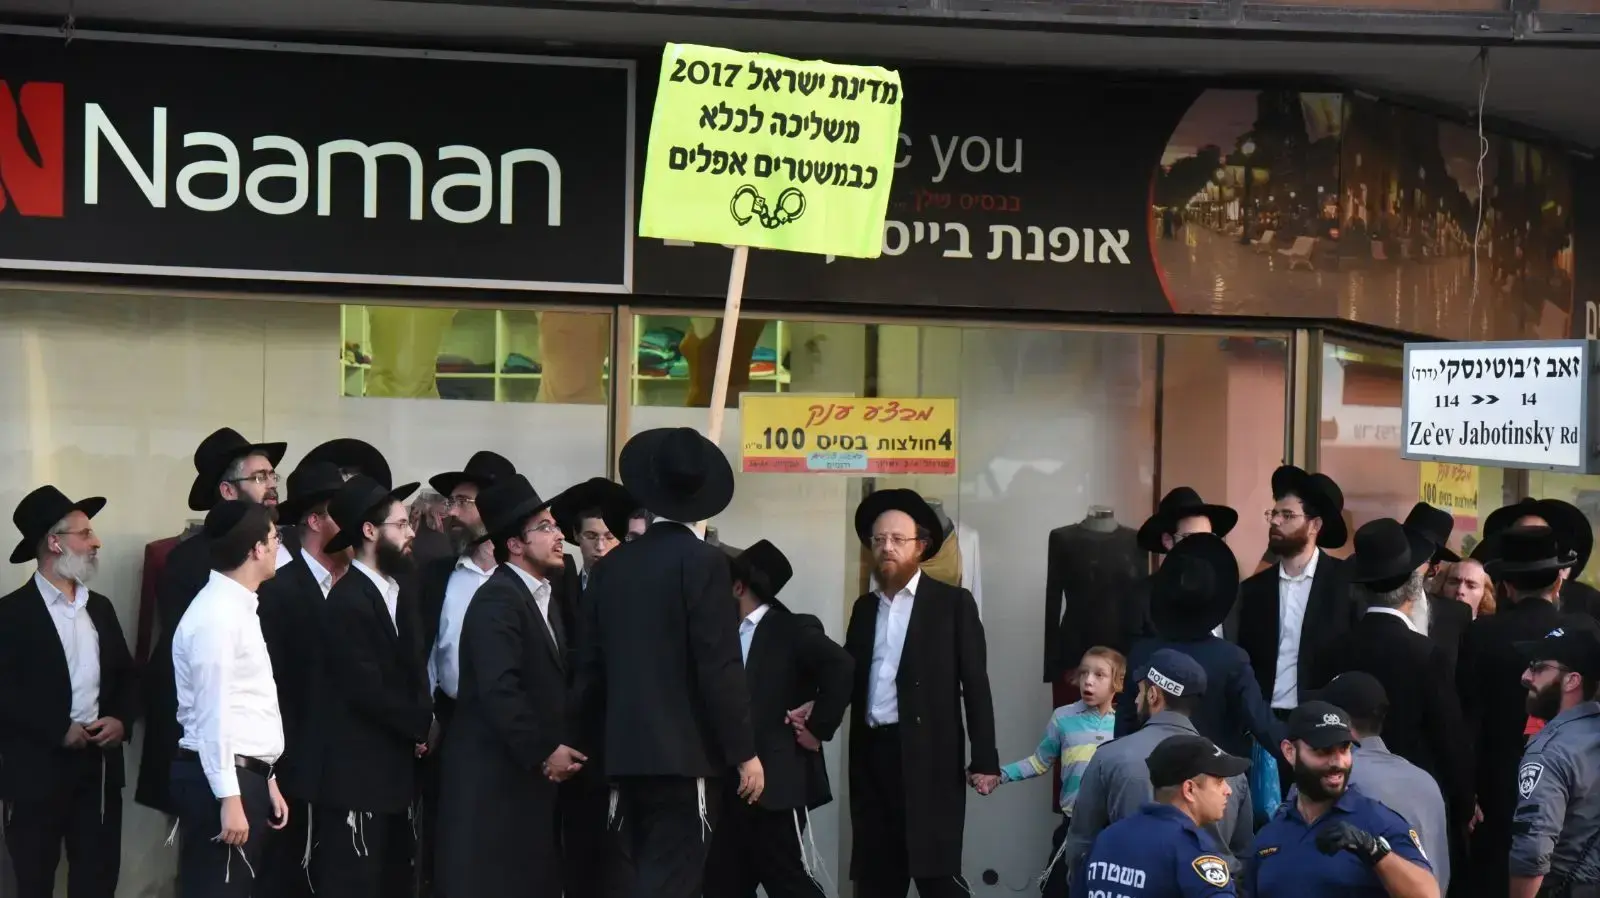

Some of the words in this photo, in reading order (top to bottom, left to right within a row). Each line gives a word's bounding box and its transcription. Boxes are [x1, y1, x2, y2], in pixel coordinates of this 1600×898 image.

[669, 58, 743, 87] 2017
[747, 61, 825, 96] ישראל
[829, 75, 898, 105] מדינת
[699, 101, 764, 133] לכלא
[770, 110, 860, 144] משליכה
[84, 102, 561, 226] Naaman
[668, 142, 748, 176] אפלים
[754, 153, 878, 189] כבמשטרים
[930, 134, 1023, 183] you
[986, 223, 1131, 264] אופנת
[1546, 355, 1580, 378] זאב
[805, 403, 854, 428] ענק
[863, 401, 935, 422] מבצע
[1434, 394, 1460, 408] 114
[1521, 392, 1537, 406] 14
[816, 434, 869, 450] בסיס
[1459, 419, 1555, 452] Jabotinsky
[1560, 426, 1578, 445] Rd
[1150, 670, 1182, 694] POLICE
[1088, 861, 1146, 889] משטרה
